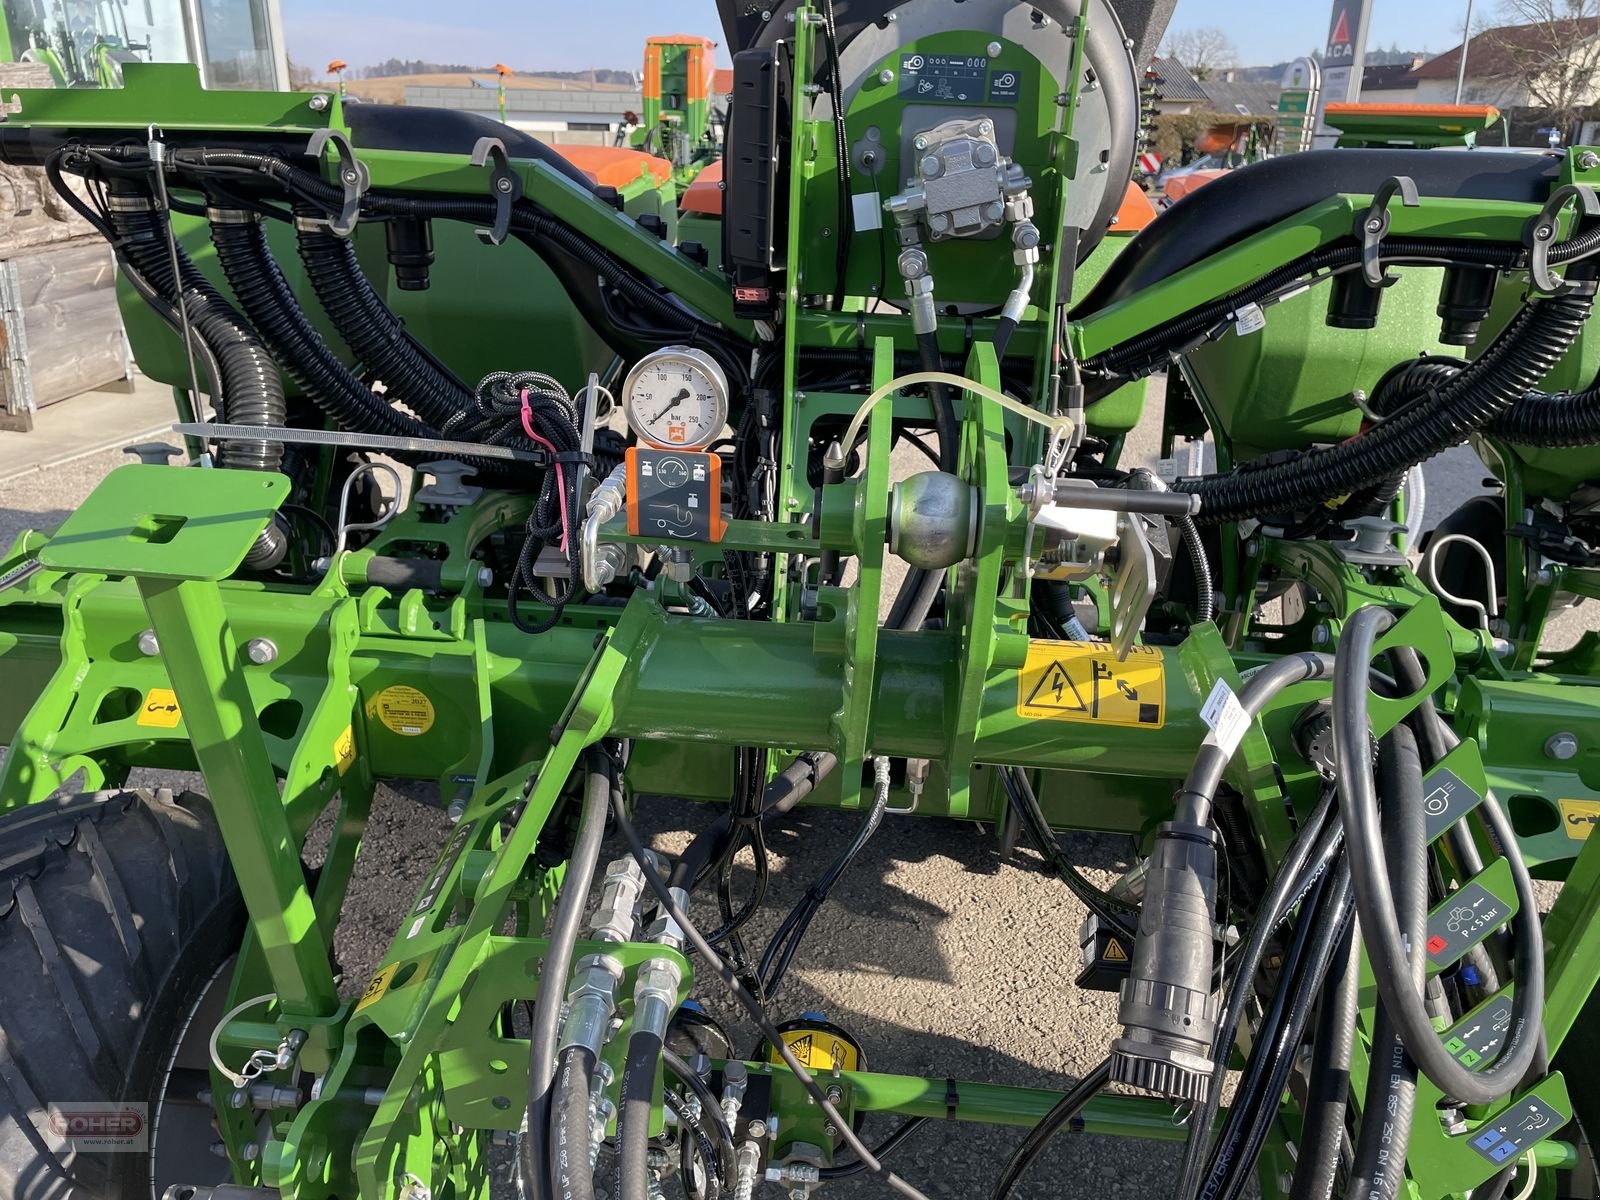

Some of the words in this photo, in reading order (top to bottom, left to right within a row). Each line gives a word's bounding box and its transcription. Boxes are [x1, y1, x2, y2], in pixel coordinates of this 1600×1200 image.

[657, 373, 667, 381] 100
[681, 374, 692, 382] 150
[670, 413, 681, 421] bar
[1461, 929, 1469, 938] P
[1474, 919, 1484, 927] 5
[1481, 907, 1498, 922] bar
[1430, 940, 1440, 948] T
[1450, 1041, 1459, 1049] 1
[1392, 1047, 1403, 1069] DIN
[1465, 1054, 1475, 1062] 2
[1389, 1073, 1401, 1090] EN
[1387, 1094, 1399, 1117] 857
[1377, 1150, 1389, 1166] DN
[1499, 1147, 1508, 1155] 2
[560, 1149, 568, 1170] 250
[561, 1174, 569, 1188] WP
[1373, 1171, 1385, 1186] 16
